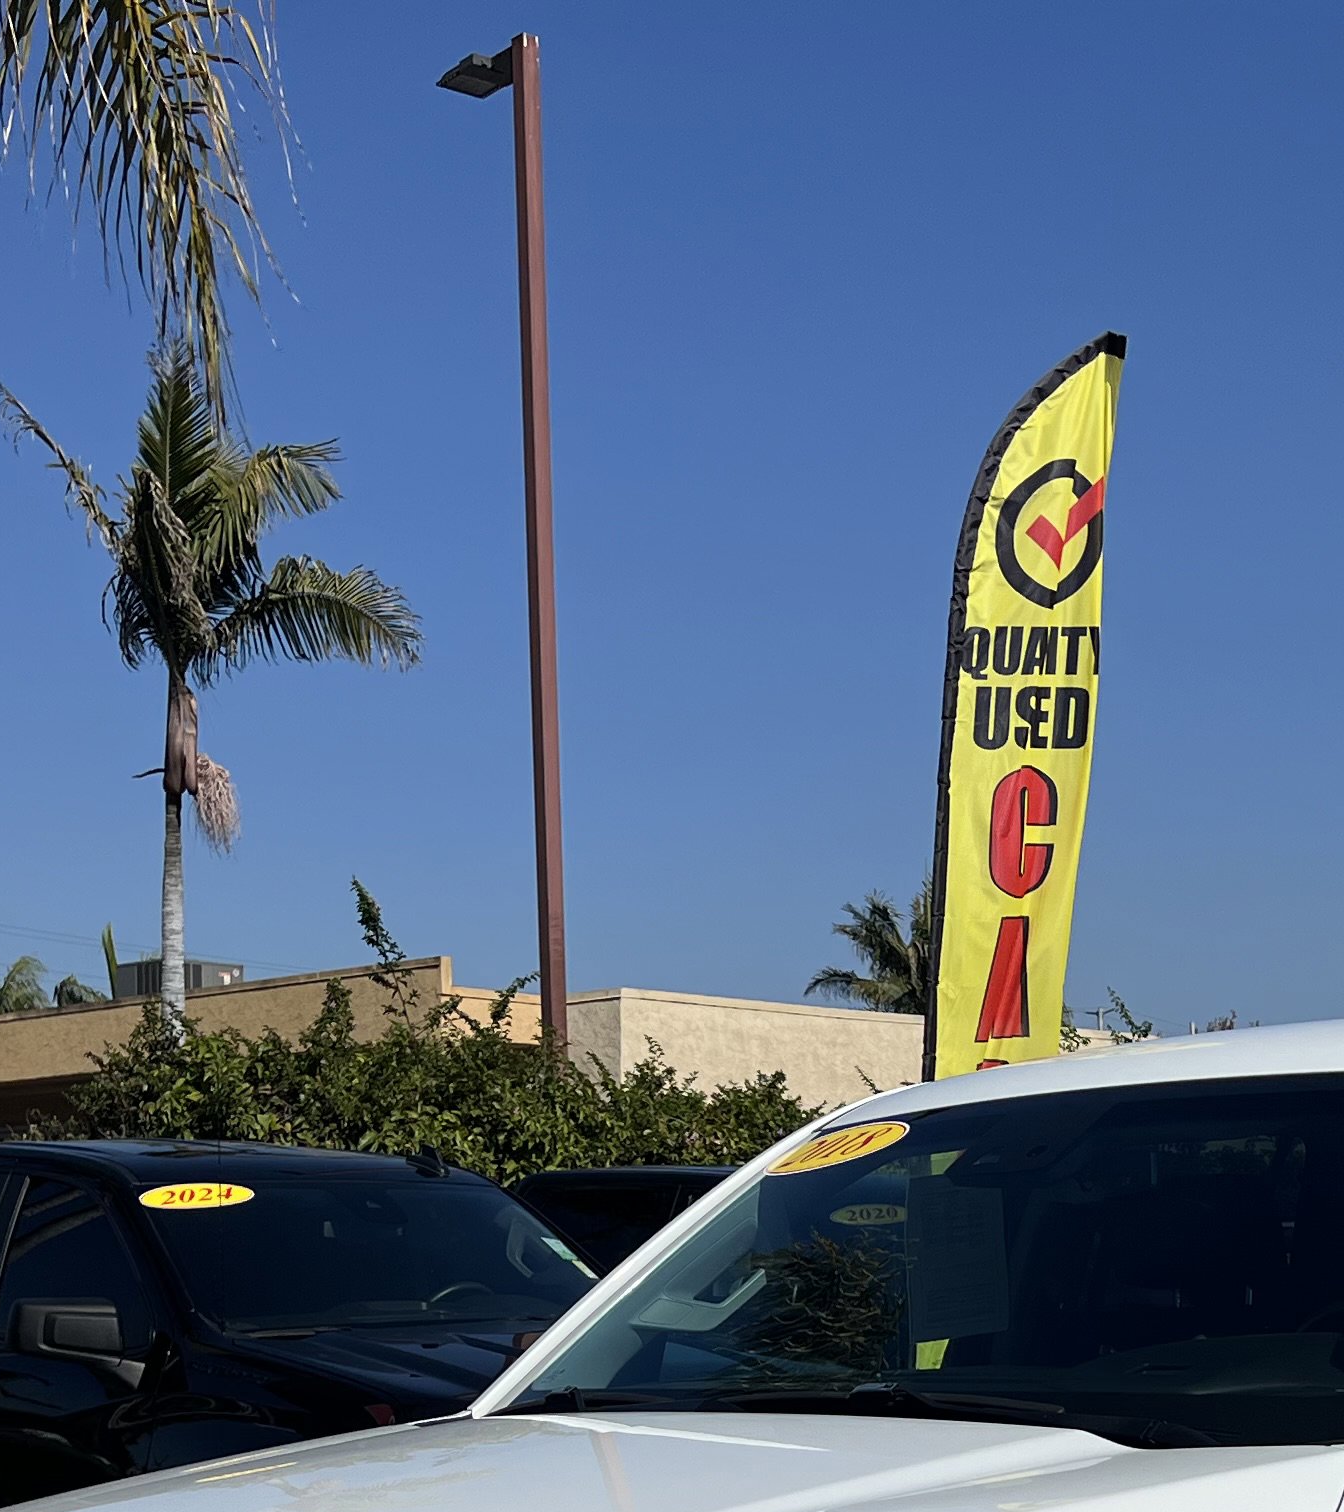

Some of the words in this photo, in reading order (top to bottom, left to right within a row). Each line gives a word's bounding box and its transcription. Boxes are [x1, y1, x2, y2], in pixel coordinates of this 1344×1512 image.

[973, 686, 1090, 750] USED
[162, 1187, 233, 1205] 2024
[847, 1207, 898, 1222] 2020
